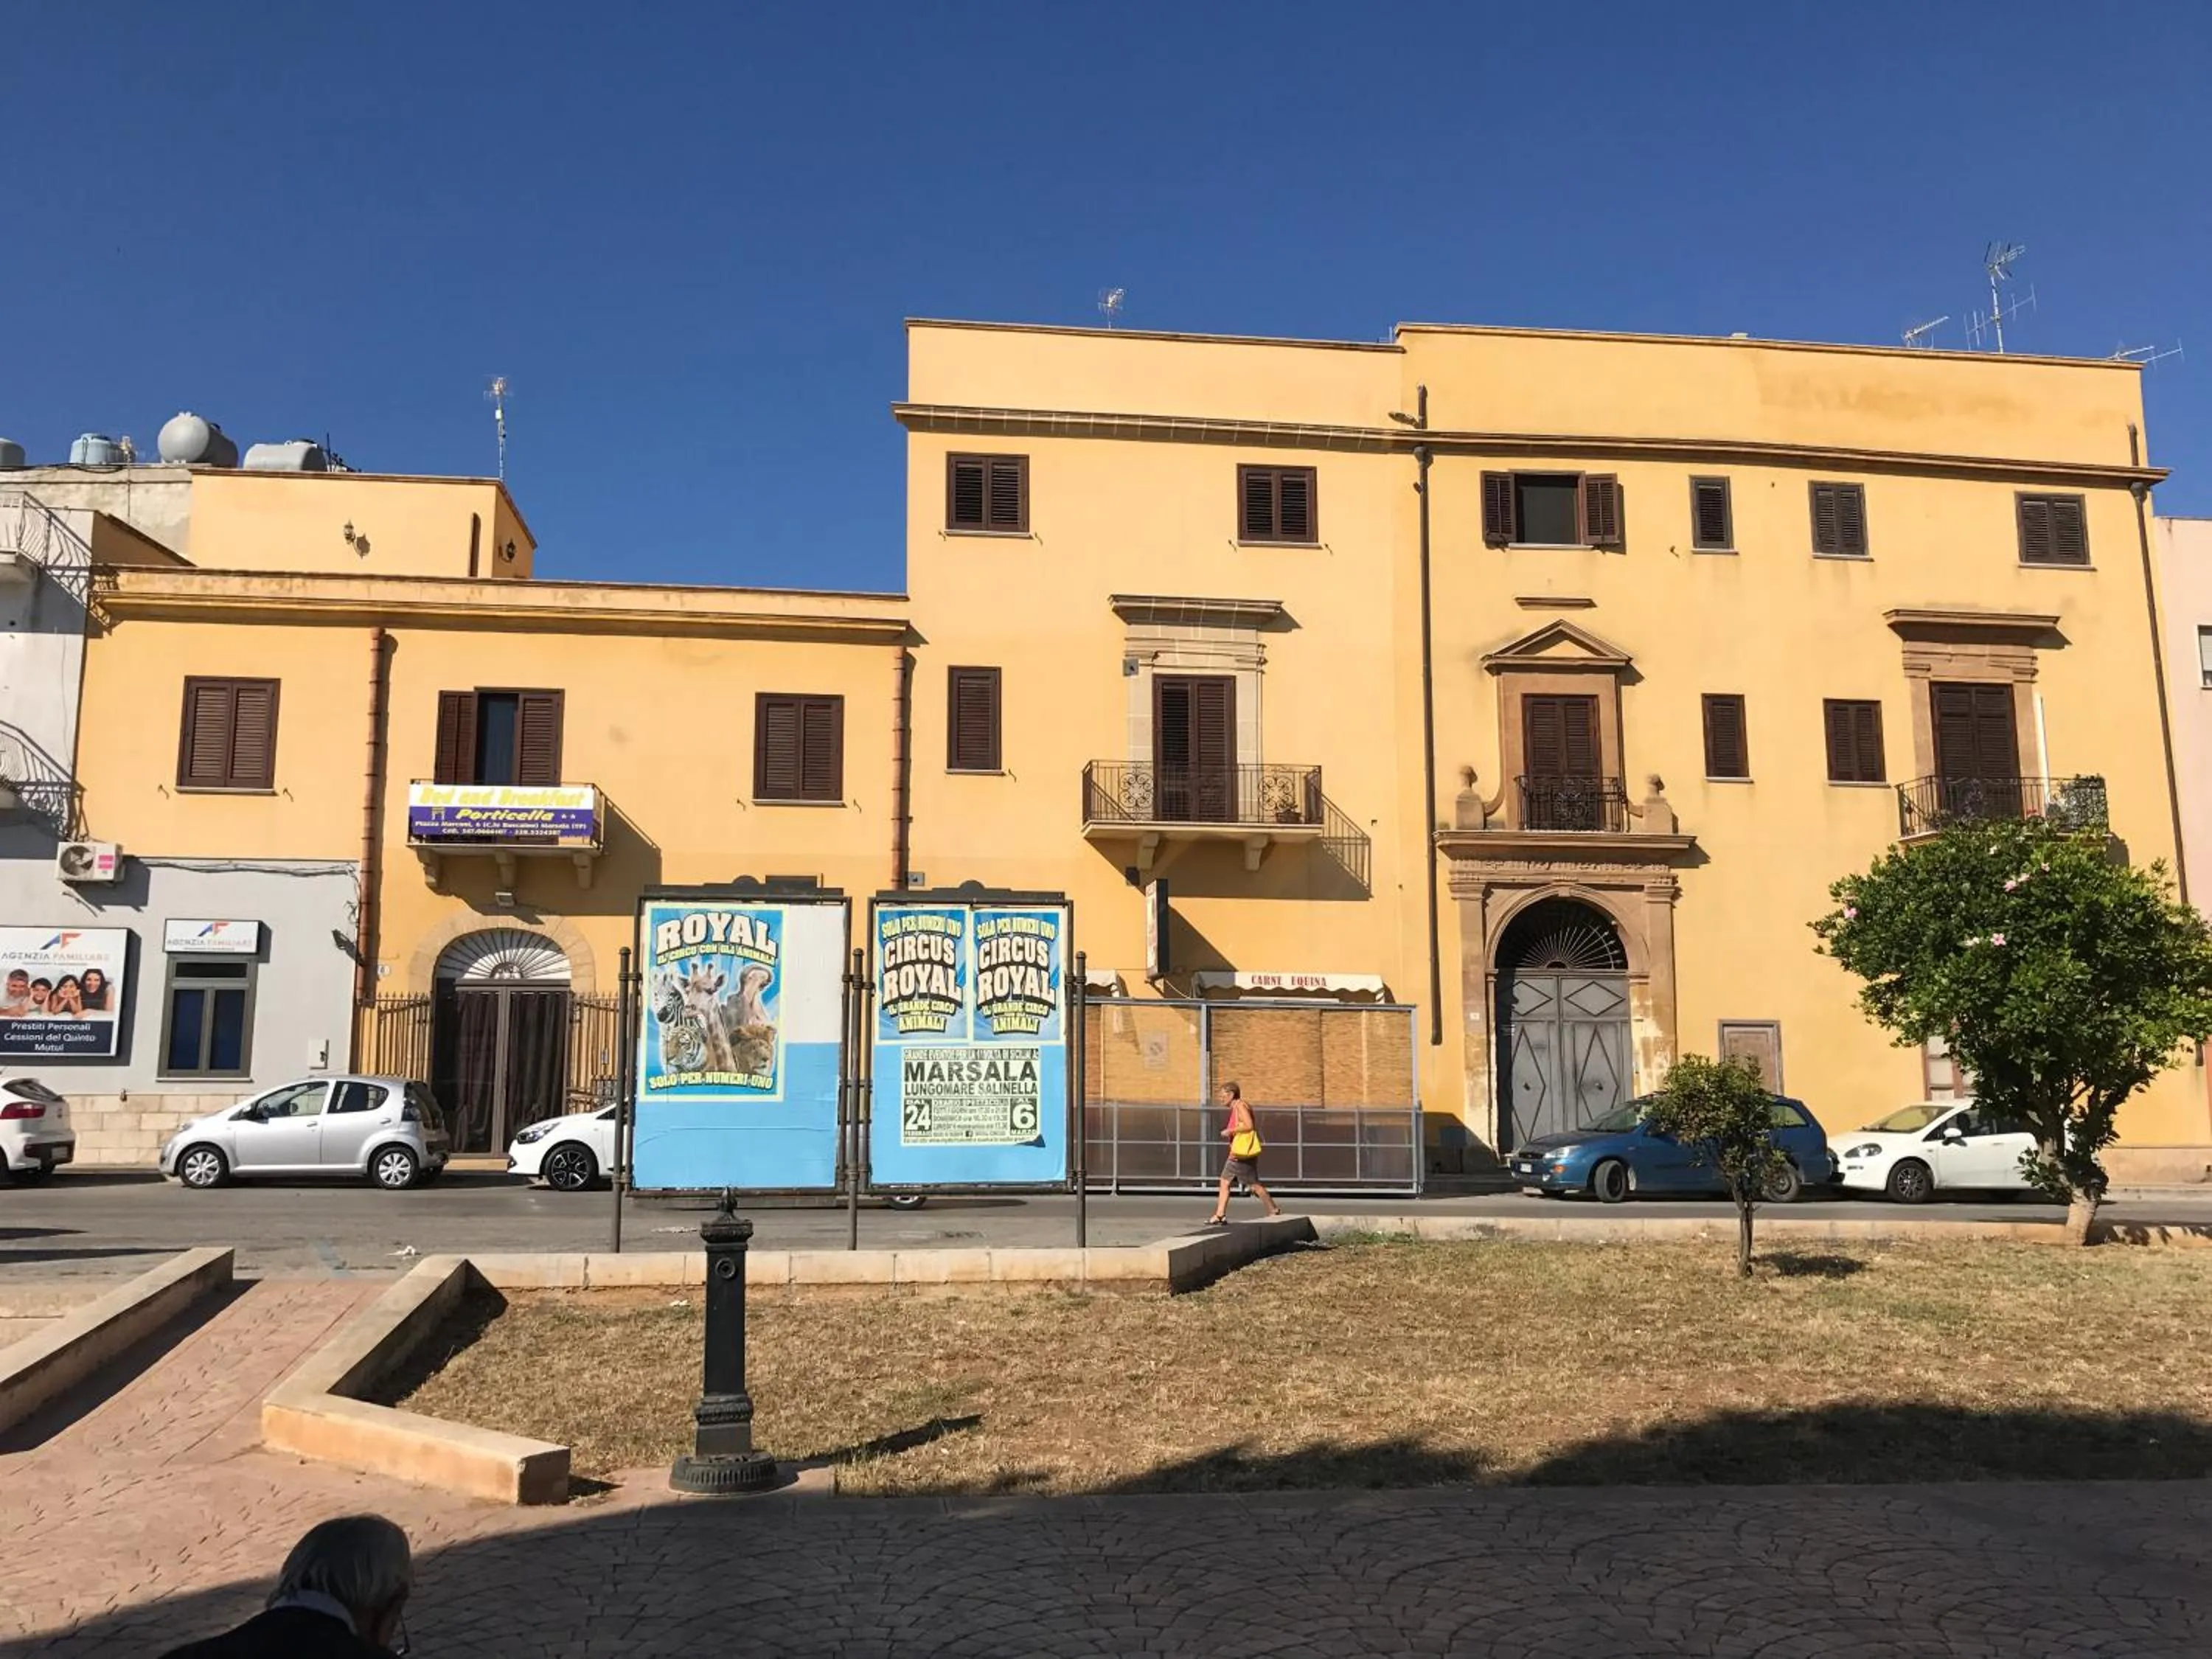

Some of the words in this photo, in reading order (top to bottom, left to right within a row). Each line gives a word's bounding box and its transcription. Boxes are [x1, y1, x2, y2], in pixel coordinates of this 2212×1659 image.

[419, 787, 455, 804] Bed
[457, 787, 495, 805] and
[498, 788, 585, 808] Breakfast
[455, 809, 555, 822] Porticella
[656, 911, 777, 957] ROYAL
[1, 952, 49, 960] AGENZIA
[52, 953, 110, 961] FAMILIARE
[700, 944, 718, 954] CON
[884, 934, 956, 969] CIRCUS
[978, 936, 1049, 970] CIRCUS
[883, 963, 963, 1005] ROYAL
[977, 965, 1055, 1006] ROYAL
[1251, 975, 1281, 986] CARNE
[1291, 975, 1327, 987] EQUINA
[898, 1000, 930, 1014] GRANDE
[931, 1000, 956, 1015] CIRCO
[1024, 1002, 1050, 1017] CIRCO
[11, 1022, 46, 1031] Prestiti
[48, 1023, 91, 1031] Personali
[898, 1015, 946, 1031] ANIMALI
[993, 1018, 1040, 1033] ANIMALI
[4, 1032, 44, 1041] Cessioni
[46, 1033, 61, 1042] del
[63, 1033, 96, 1042] Quinto
[904, 1061, 1038, 1082] MARSALA
[648, 1073, 678, 1089] SOLO
[680, 1071, 702, 1085] PER
[705, 1071, 748, 1086] NUMERI
[751, 1074, 773, 1089] UNO
[904, 1082, 975, 1096] LUNGOMARE
[978, 1082, 1038, 1096] SALINELLA
[905, 1104, 931, 1130] 24
[1012, 1104, 1036, 1130] 6
